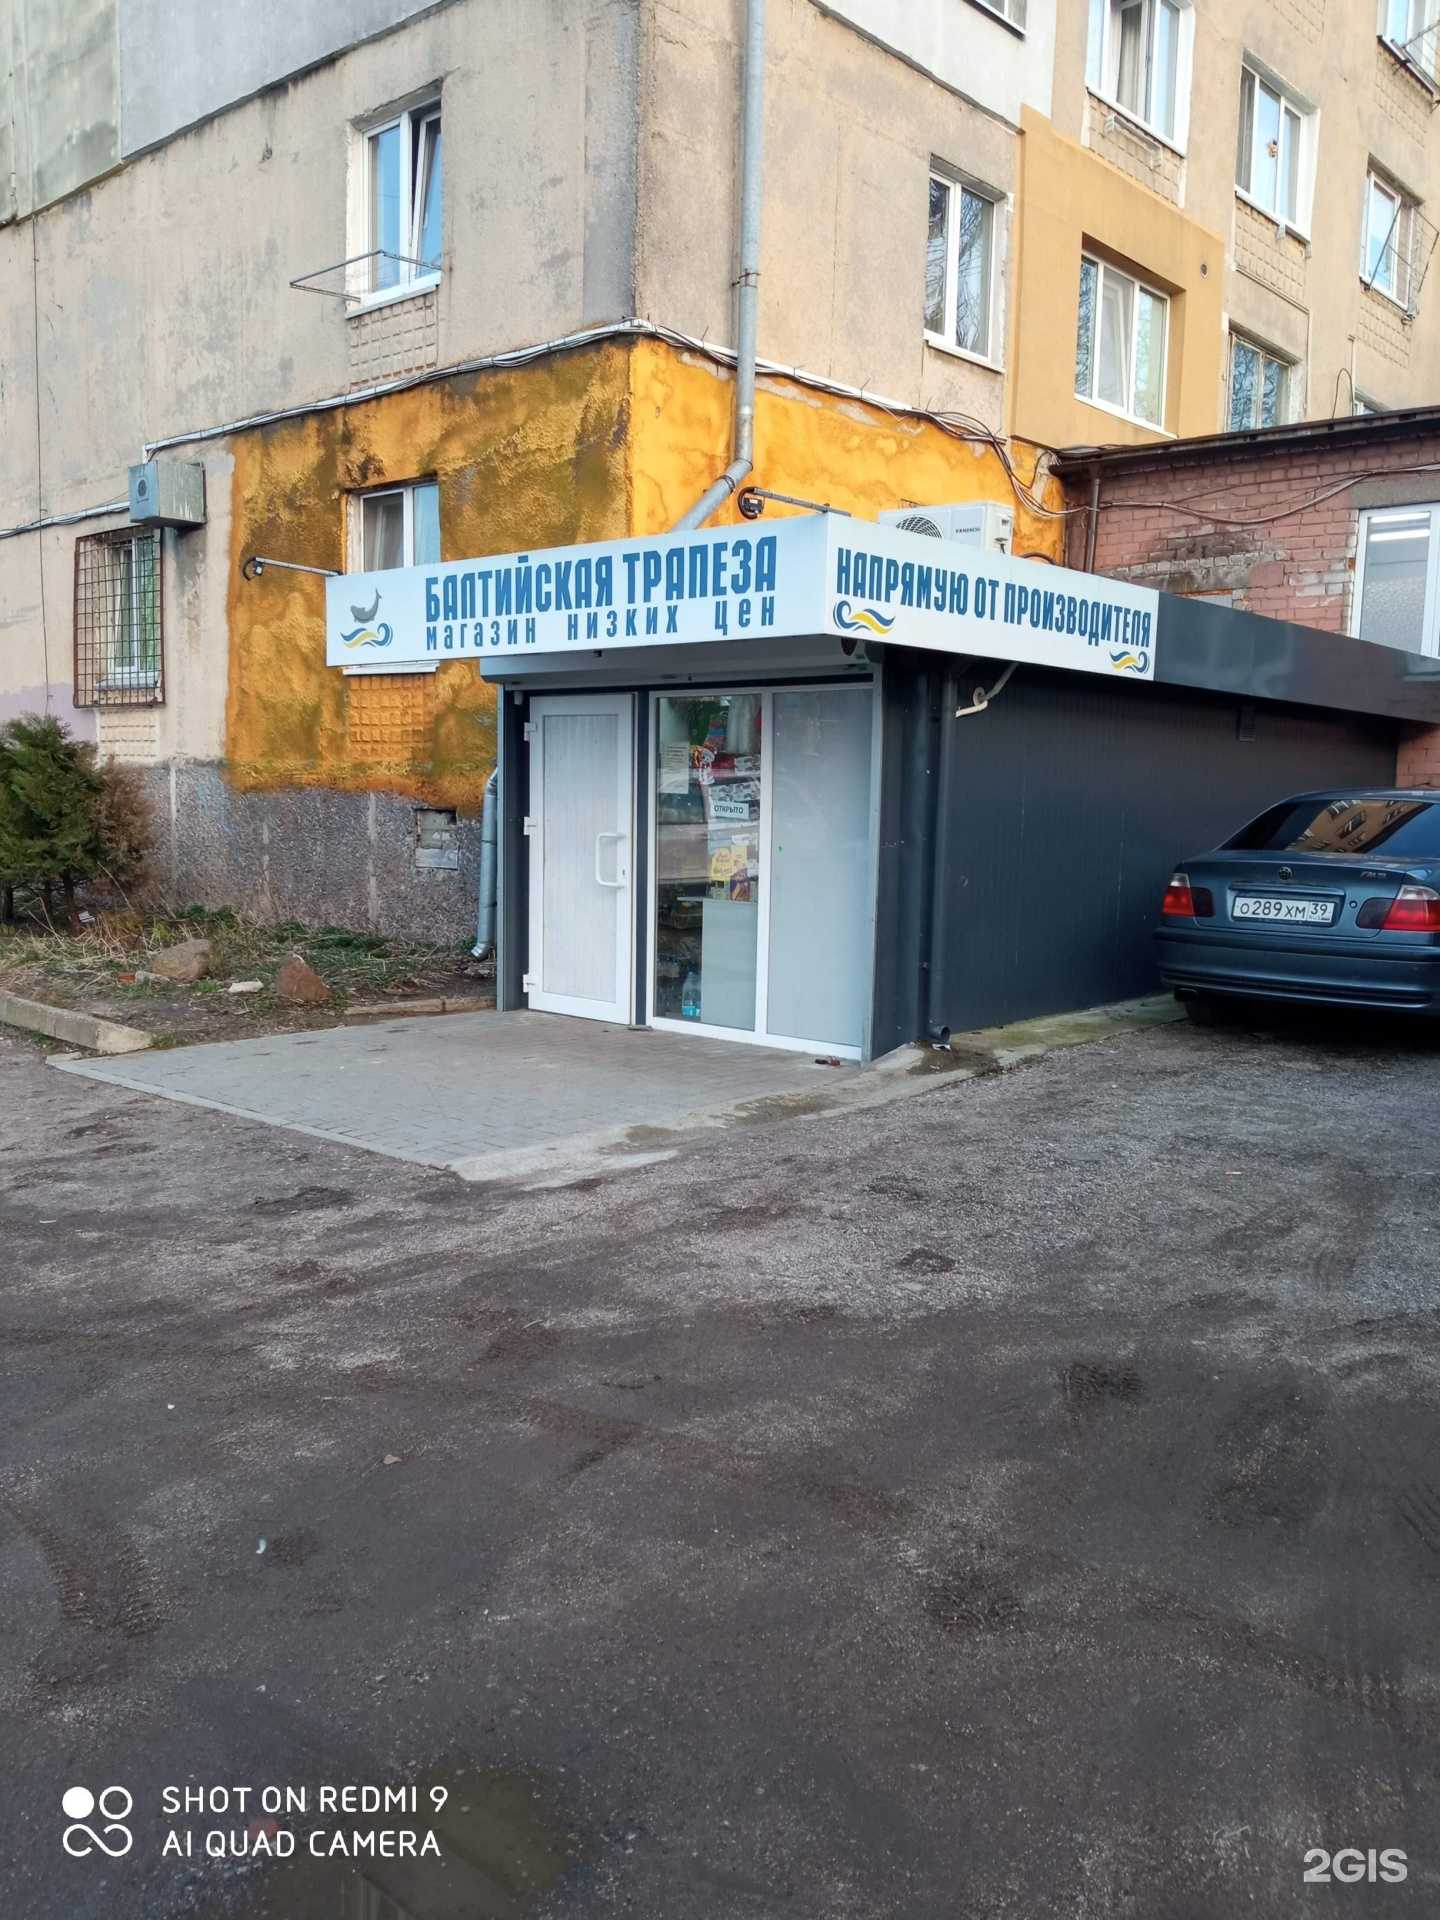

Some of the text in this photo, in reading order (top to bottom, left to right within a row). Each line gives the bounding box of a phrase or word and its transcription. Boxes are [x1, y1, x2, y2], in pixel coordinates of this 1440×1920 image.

[425, 536, 776, 622] БАЛТИЙСКАЯ ТРАПЕЗА
[836, 547, 1152, 647] НАПРЯМУЮ ОТ ПРОИЗВОДИТЕЛЯ
[426, 596, 774, 650] магазин низких цен
[714, 805, 743, 814] ОТКРЫТО
[1310, 902, 1328, 916] 39
